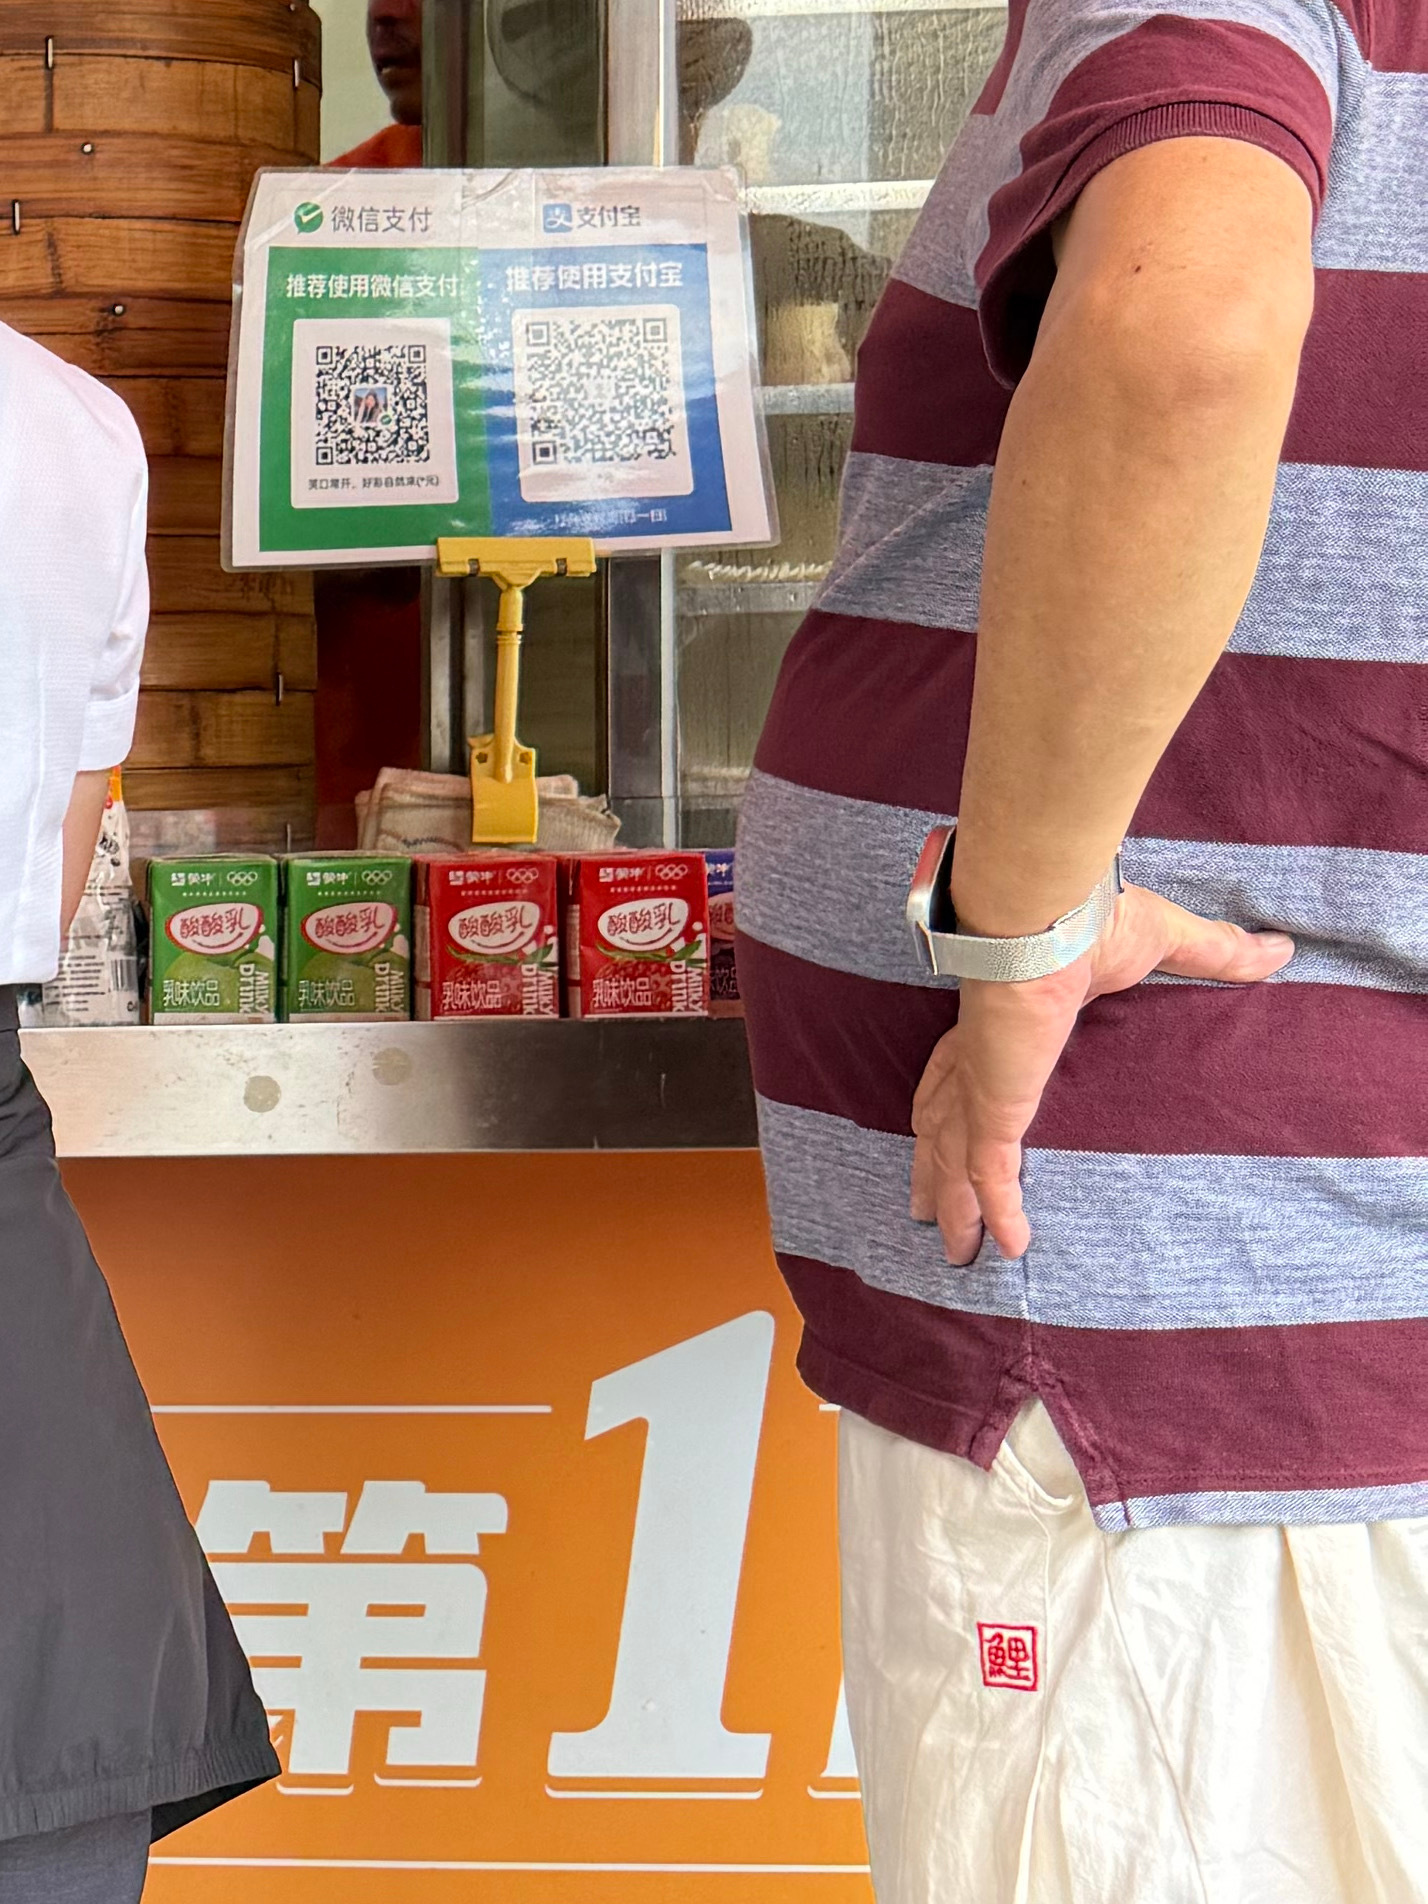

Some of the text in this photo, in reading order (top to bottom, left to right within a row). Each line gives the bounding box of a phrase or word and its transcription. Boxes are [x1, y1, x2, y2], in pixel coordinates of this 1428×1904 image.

[331, 206, 433, 232] 微信支付
[577, 205, 642, 229] 支付宝
[286, 273, 460, 299] 推荐使用微信支付
[506, 262, 684, 292] 推荐使用支付宝
[180, 906, 251, 939] 酸酸乳
[315, 906, 386, 938] 酸酸乳
[458, 905, 534, 938] 酸酸乳
[606, 902, 680, 936] 酸酸乳
[163, 980, 221, 1008] 乳味饮品
[299, 979, 356, 1007] 乳味饮品
[442, 978, 503, 1010] 乳味饮品
[592, 977, 654, 1008] 乳味饮品
